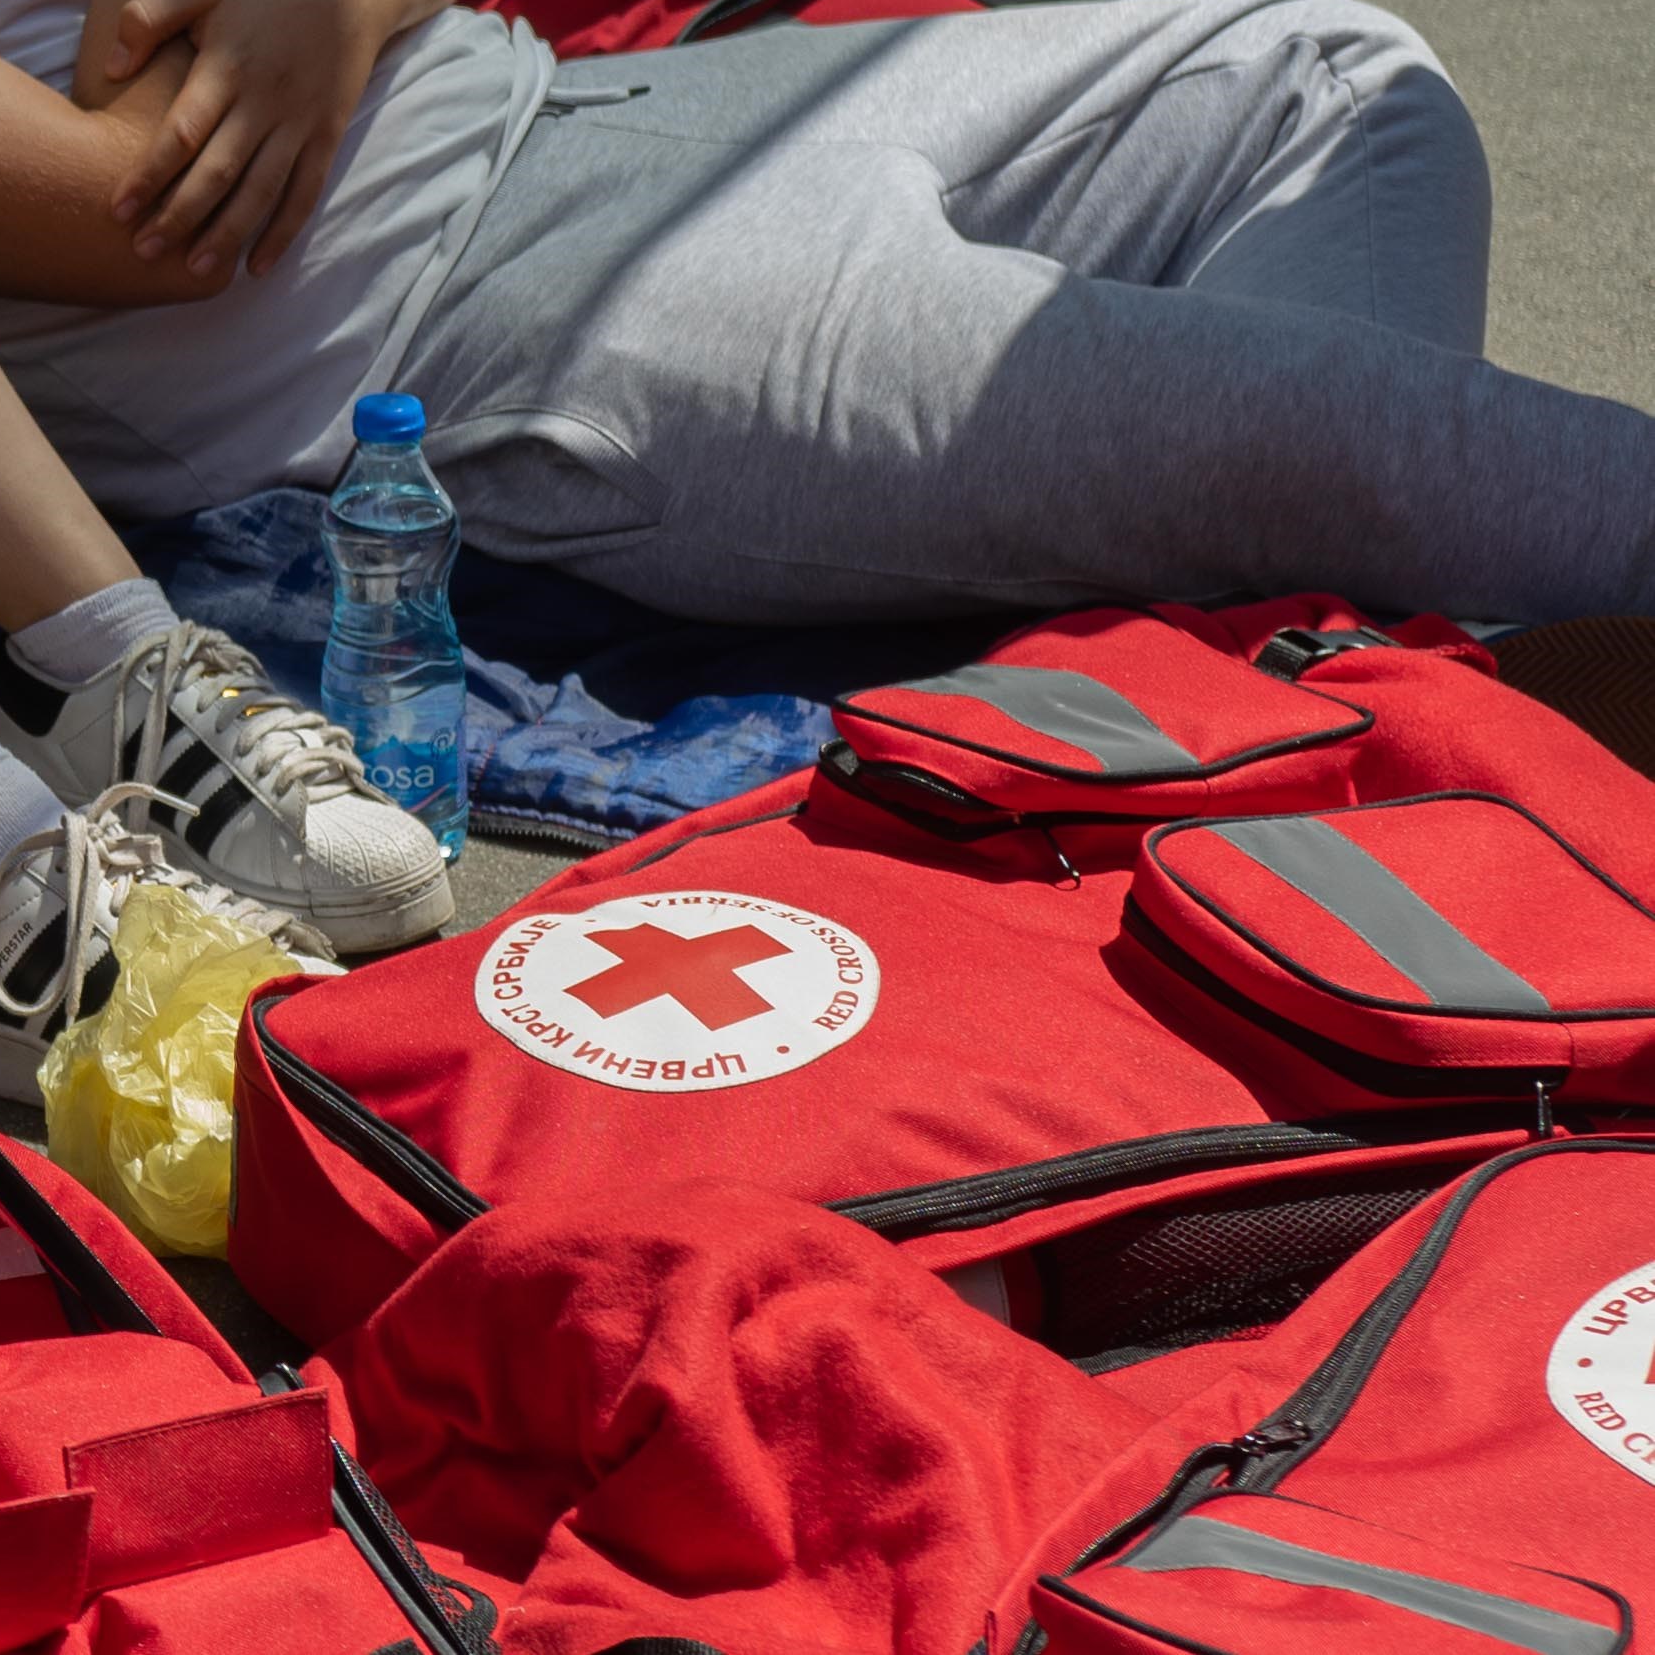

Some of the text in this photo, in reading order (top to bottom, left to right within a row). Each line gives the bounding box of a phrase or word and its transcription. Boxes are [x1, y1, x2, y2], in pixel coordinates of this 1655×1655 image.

[364, 764, 435, 791] osa
[492, 918, 749, 1082] ЦРВЕНИ КРСТ СРБИЈЕ
[639, 895, 865, 1032] RED CROSS OF SERBIA
[1573, 1391, 1627, 1432] RED
